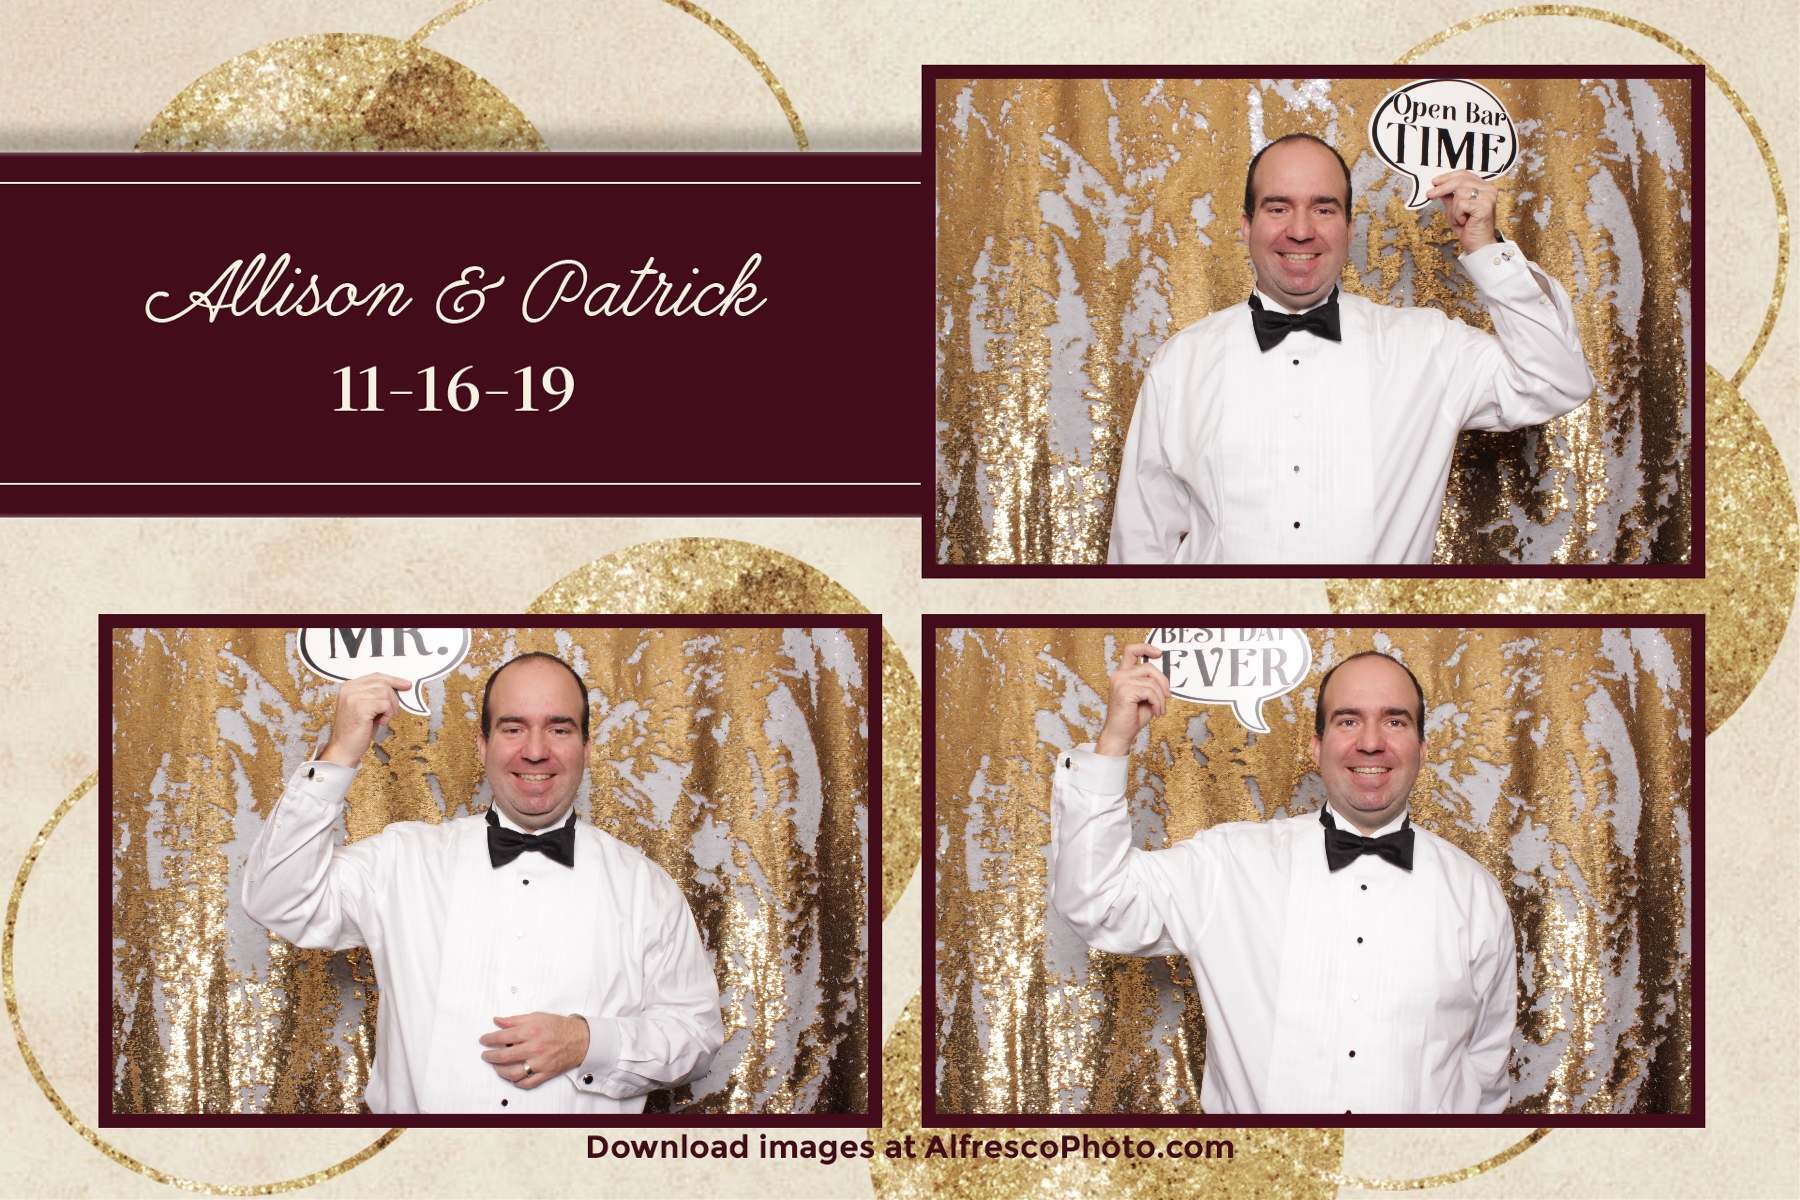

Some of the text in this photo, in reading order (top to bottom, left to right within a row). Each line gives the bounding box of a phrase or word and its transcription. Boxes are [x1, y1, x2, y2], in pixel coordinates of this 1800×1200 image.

[1393, 92, 1506, 126] Open Bar
[1386, 122, 1506, 174] TIME
[328, 628, 449, 659] MR.
[1161, 647, 1293, 688] EVER
